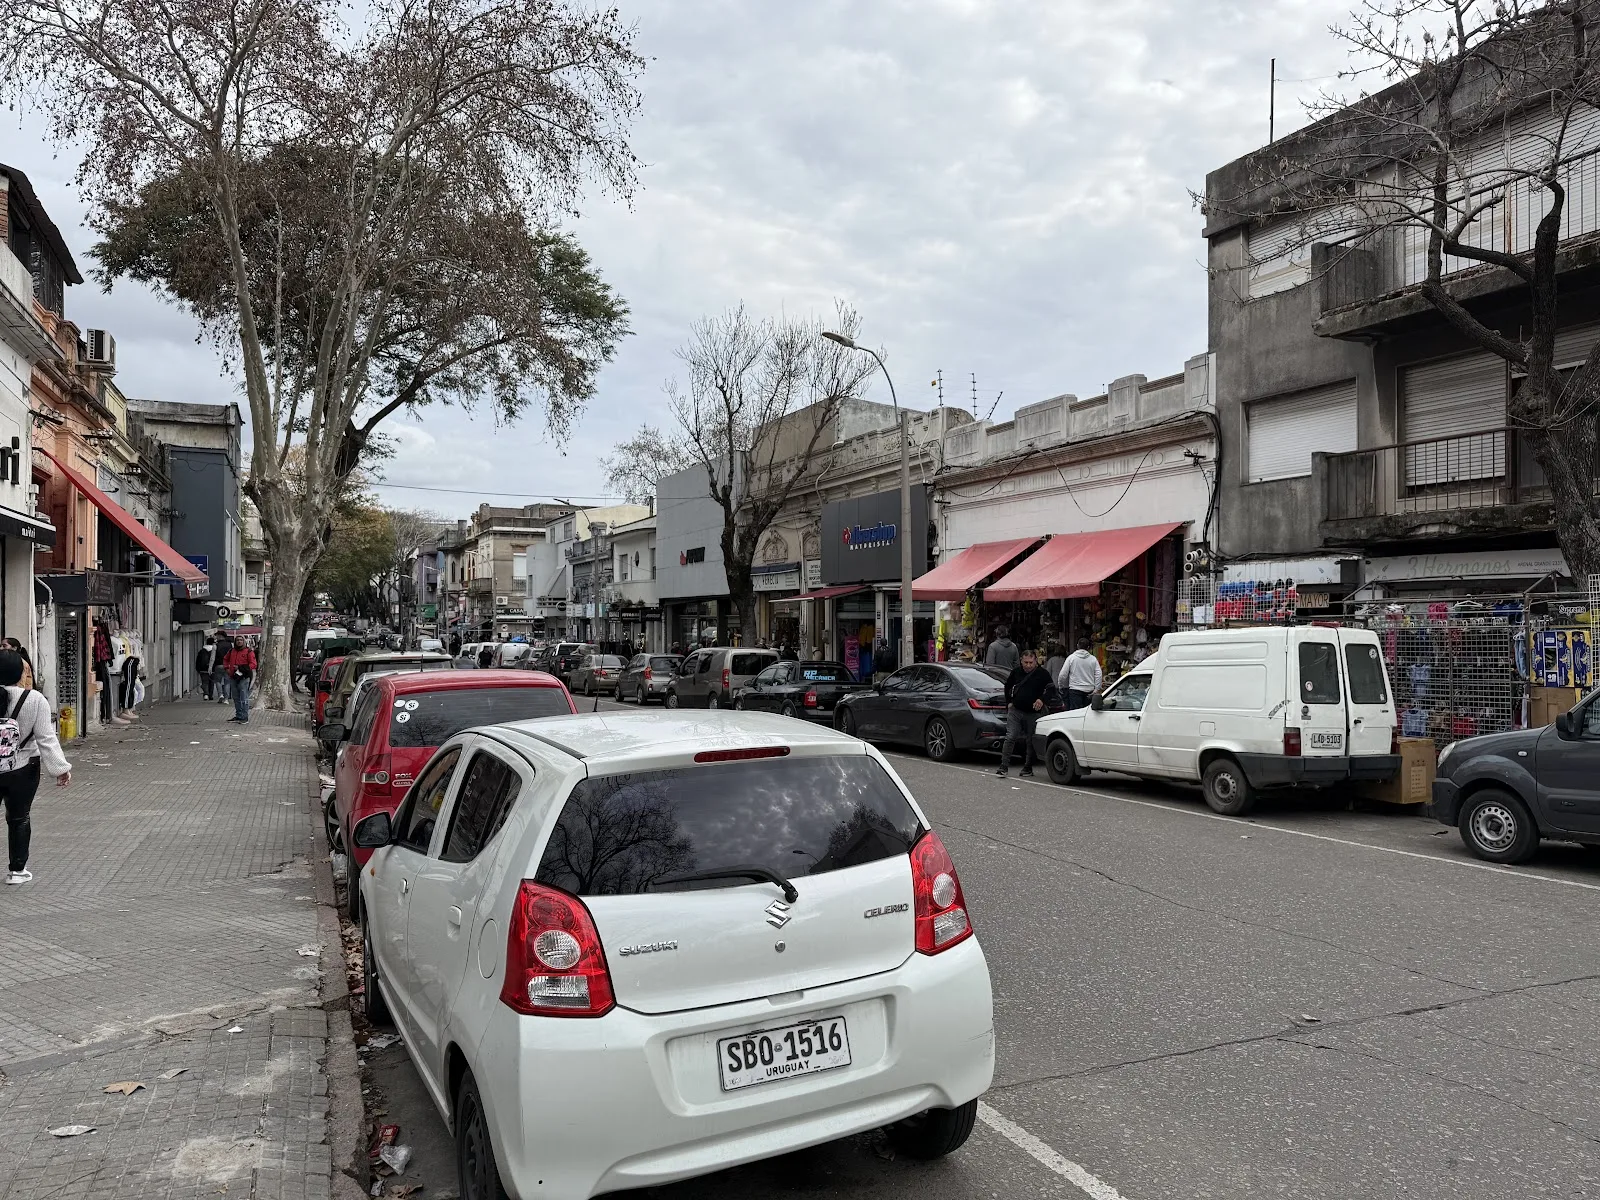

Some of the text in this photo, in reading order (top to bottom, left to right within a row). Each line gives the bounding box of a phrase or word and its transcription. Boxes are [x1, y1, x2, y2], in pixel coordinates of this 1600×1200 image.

[1407, 555, 1511, 579] 3 Hermanos
[1300, 593, 1329, 608] MAYOR
[1559, 605, 1587, 616] Suprema
[803, 670, 818, 678] RP
[1326, 735, 1341, 744] 5103
[864, 902, 910, 919] CELERIO
[619, 940, 679, 957] SUZUKI
[727, 1022, 842, 1073] SBO 1516
[766, 1060, 810, 1077] URUGUAY
